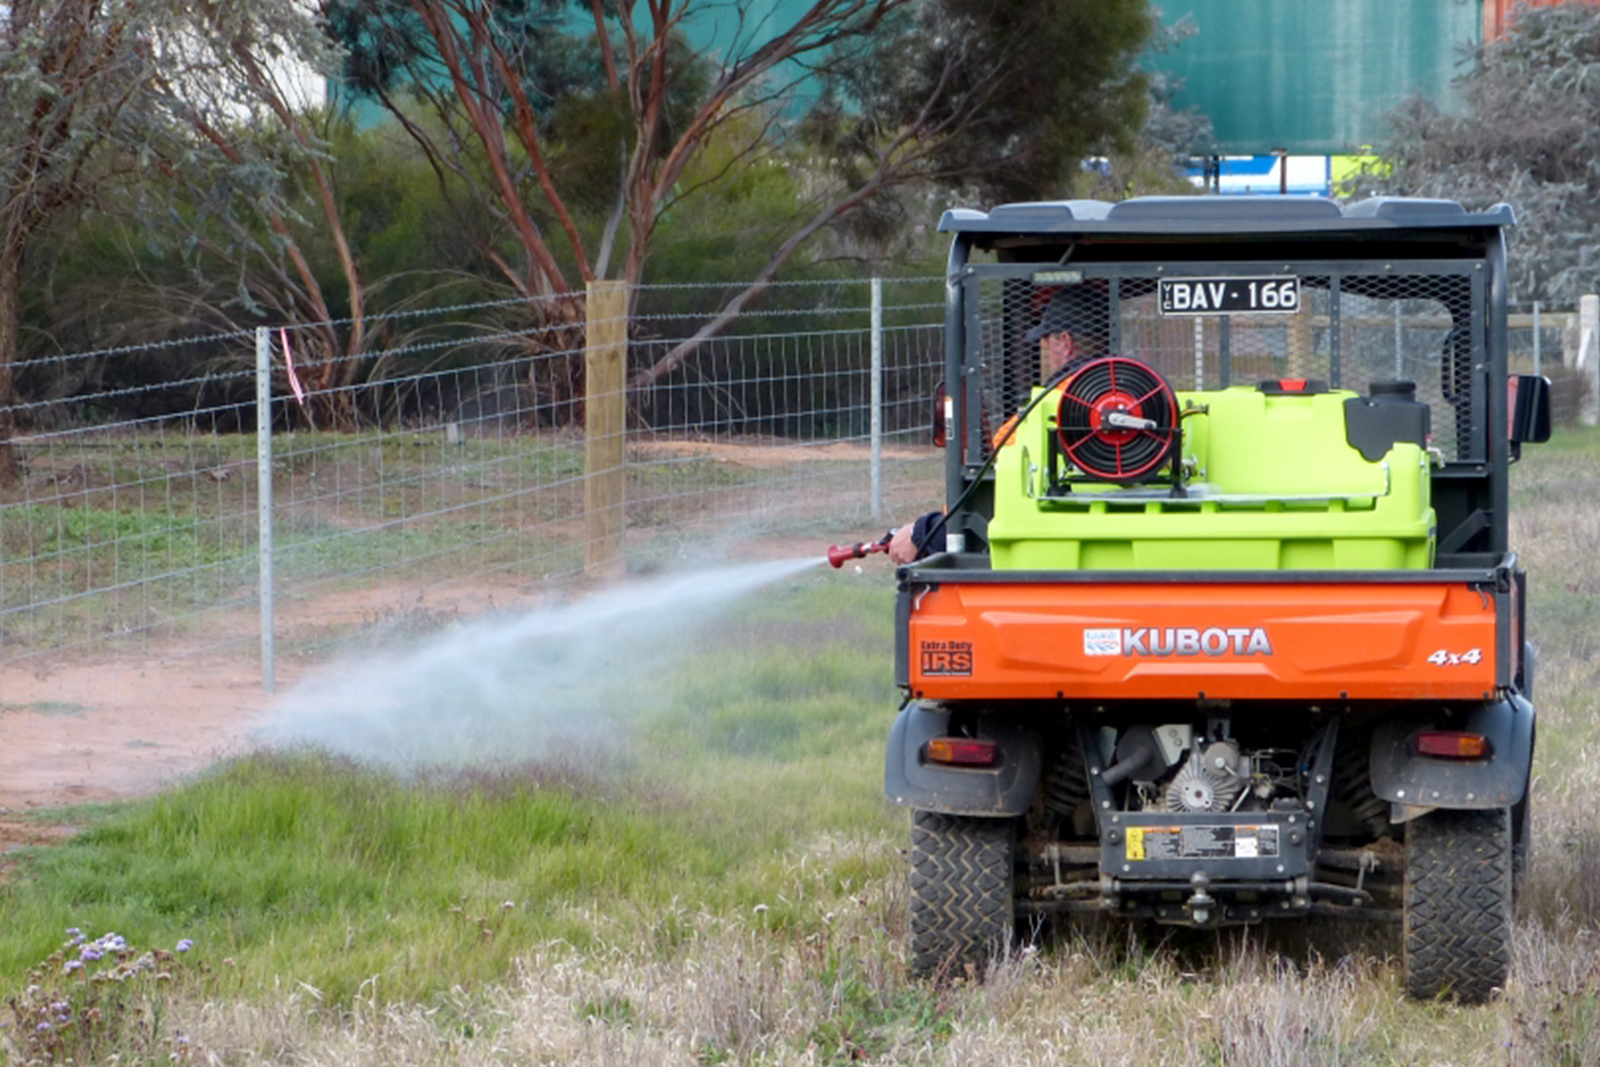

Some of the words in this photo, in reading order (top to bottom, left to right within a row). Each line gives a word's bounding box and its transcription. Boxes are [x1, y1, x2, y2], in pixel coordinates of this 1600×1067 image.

[1163, 284, 1172, 310] VIC
[1173, 283, 1226, 310] BAV
[1249, 282, 1296, 308] 166
[1123, 627, 1274, 656] KUBOTA
[922, 652, 971, 671] IRS
[1427, 647, 1482, 666] 4x4
